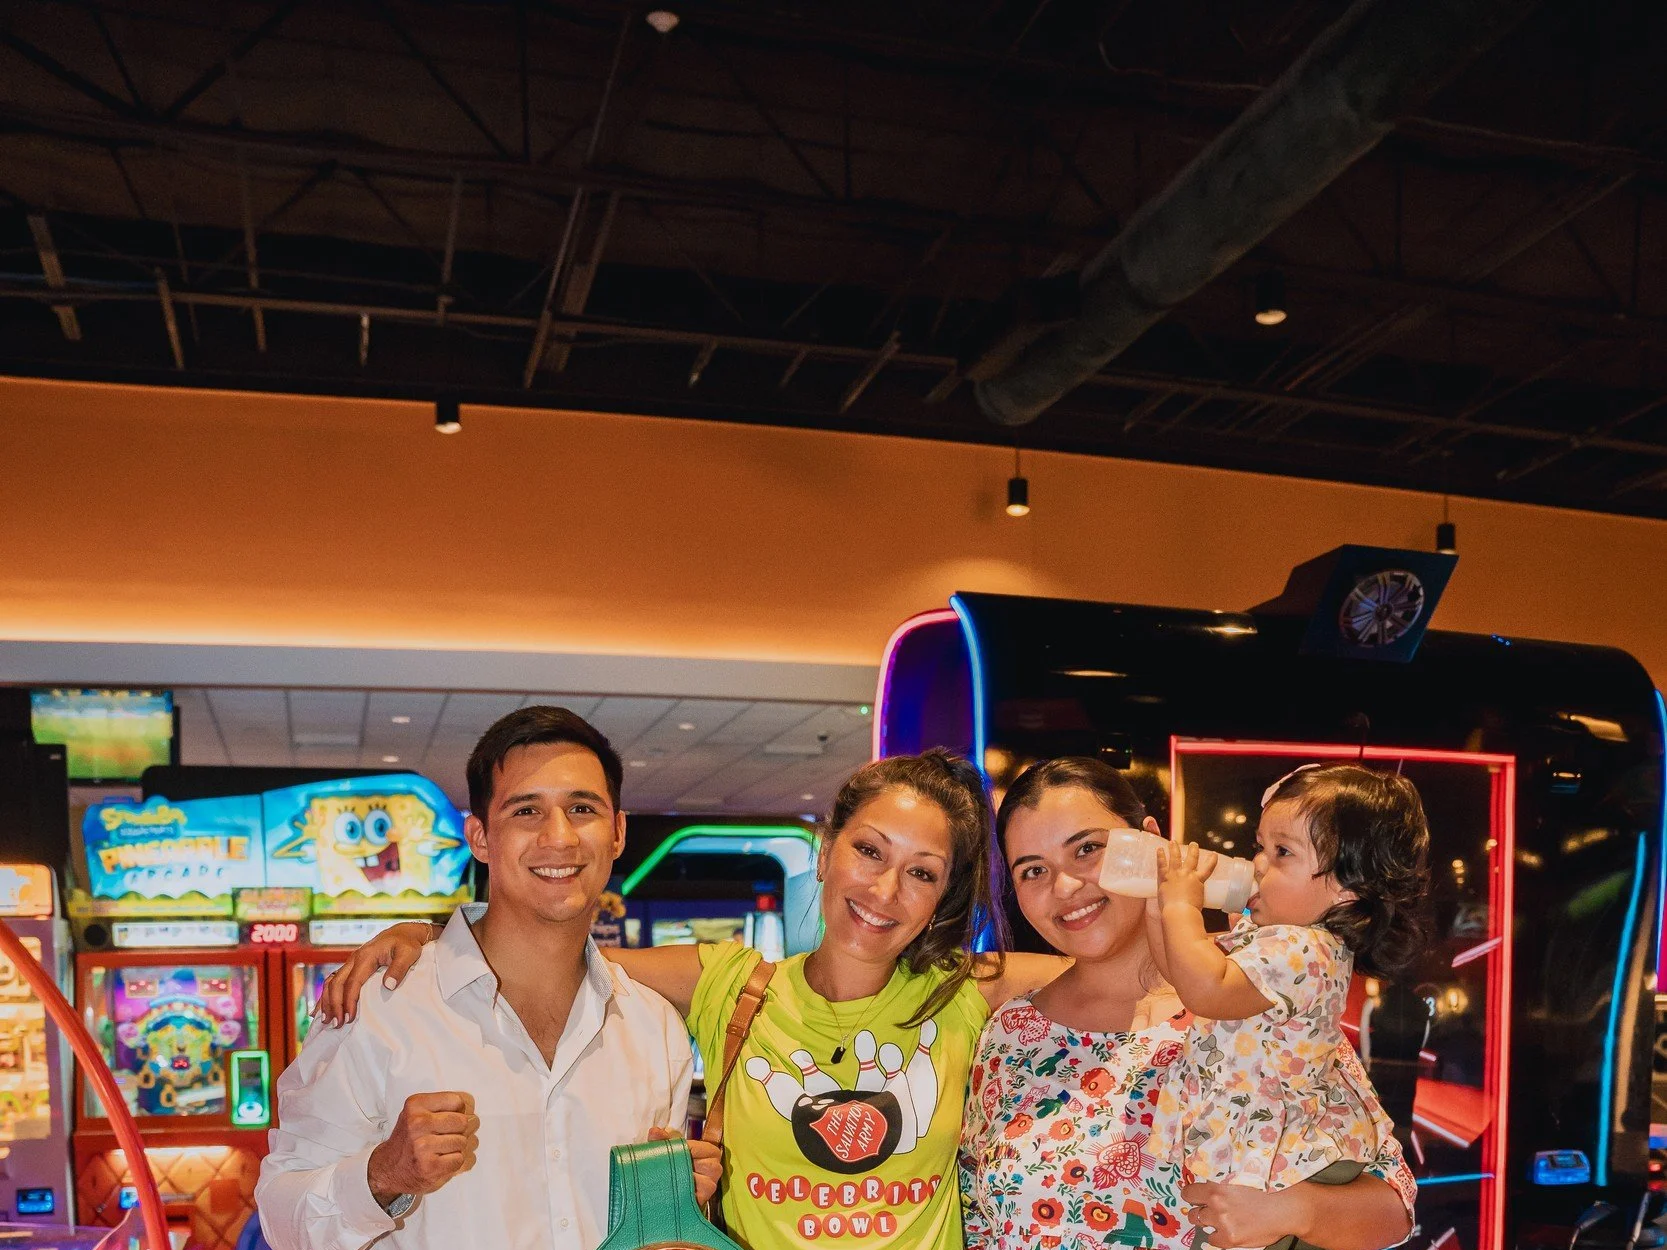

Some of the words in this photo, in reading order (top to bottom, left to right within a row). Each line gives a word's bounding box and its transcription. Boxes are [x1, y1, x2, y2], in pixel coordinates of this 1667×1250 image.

[98, 836, 248, 874] PINEAPPLE
[251, 924, 298, 942] 2000
[826, 1109, 844, 1136] THE
[835, 1103, 864, 1159] SALVATION
[856, 1111, 876, 1152] ARMY
[803, 1217, 890, 1236] BOWL
